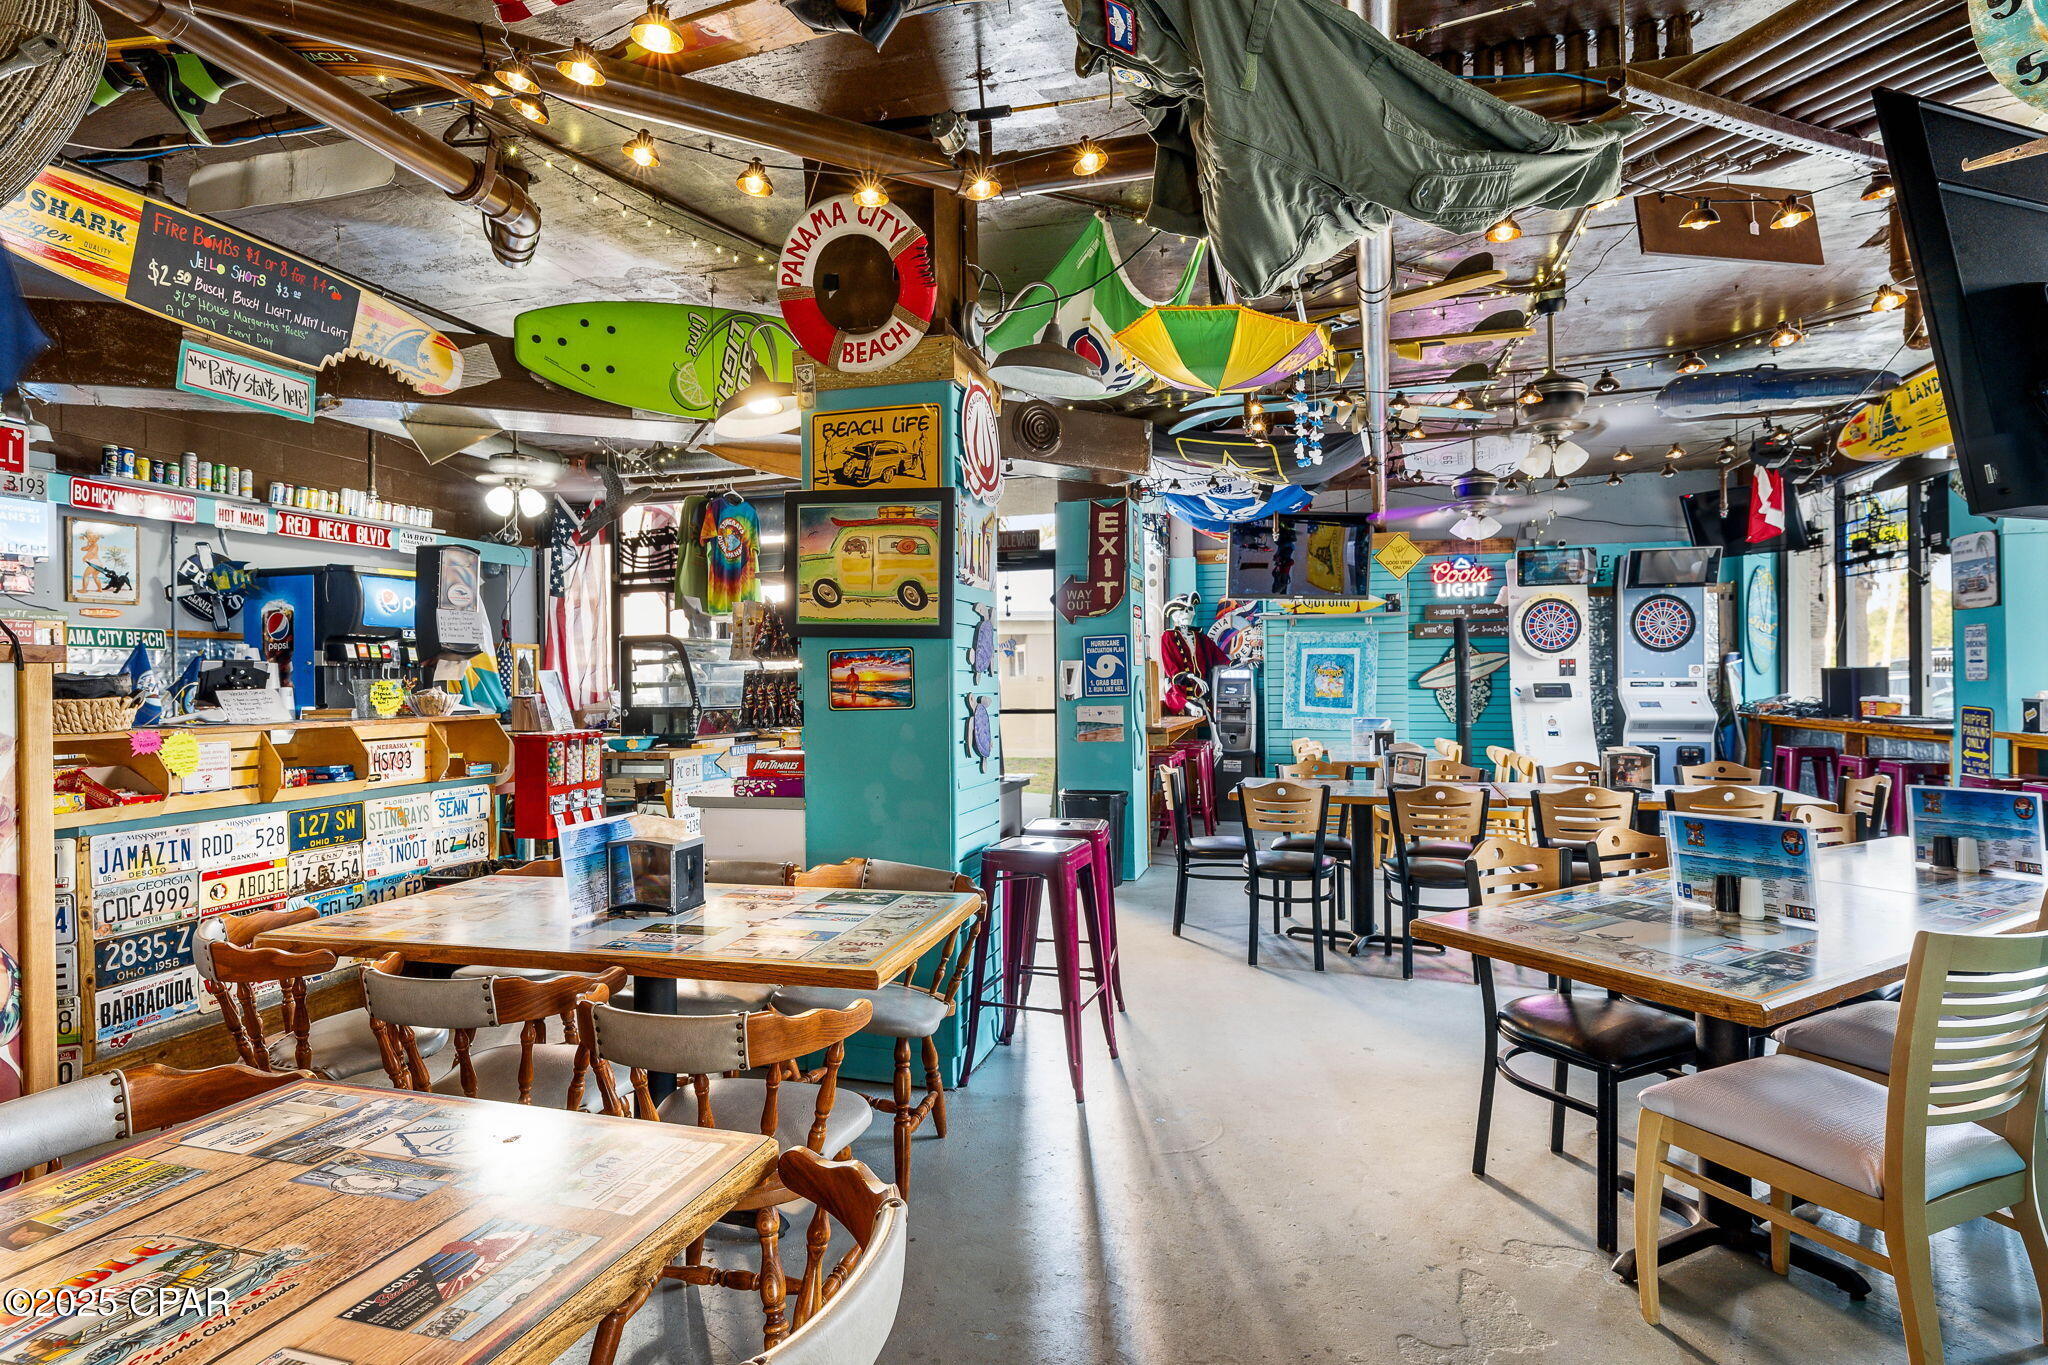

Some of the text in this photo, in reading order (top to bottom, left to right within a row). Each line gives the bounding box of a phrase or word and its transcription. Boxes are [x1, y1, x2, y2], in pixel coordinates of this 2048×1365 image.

[30, 188, 127, 243] SHARK
[83, 240, 112, 255] QUALITY
[781, 201, 908, 287] PANAMA CITY
[190, 251, 226, 275] JELLO
[230, 264, 267, 288] SHOTS
[280, 260, 288, 277] 8
[321, 320, 349, 341] LIGHT
[841, 321, 911, 364] BEACH
[188, 355, 208, 370] the
[208, 359, 242, 393] Party
[243, 373, 280, 402] Starts
[822, 418, 885, 439] BEACH
[74, 484, 90, 503] BO
[218, 508, 265, 528] HOT MAMA
[285, 514, 385, 547] RED NECK BLVD
[1096, 511, 1120, 605] EXIT
[1432, 561, 1492, 584] Coors
[1066, 589, 1093, 600] WAY
[1436, 582, 1488, 598] LIGHT
[1066, 600, 1092, 611] OUT
[97, 630, 123, 647] CITY
[126, 631, 164, 647] BEACH
[268, 640, 290, 652] pepsi
[1090, 639, 1120, 647] HURRICANE
[1086, 646, 1113, 654] EVACUATION
[1110, 678, 1124, 686] BEER
[1963, 713, 1989, 727] HIPPIE
[1963, 725, 1990, 739] PARKING
[731, 743, 756, 756] WARNING
[1965, 737, 1986, 750] ONLY
[373, 750, 412, 772] HS733
[1972, 761, 1990, 769] OTHERS
[384, 797, 414, 807] FLORIDA
[437, 796, 482, 819] SENN 1
[298, 808, 356, 838] 127 SW
[368, 804, 430, 831] STINGRAYS
[202, 825, 285, 859] RDD 528
[309, 835, 344, 848] OHIO 72
[380, 834, 409, 847] ALABAMA
[465, 831, 486, 849] 468
[99, 837, 191, 876] JAMAZIN
[230, 852, 259, 862] RANKIN
[315, 852, 338, 861] TENN
[102, 867, 167, 883] 06 DESOTO
[136, 874, 192, 892] GEORGIA
[383, 872, 415, 886] Kentucky
[202, 892, 289, 915] FLORIDA STATE UNIVERSITY
[309, 888, 347, 903] FLORIDA
[102, 885, 190, 925] CDC4999
[135, 915, 163, 926] HOUSTON
[155, 957, 180, 971] 1958
[121, 975, 175, 997] DREAMBOAT ANNIE
[101, 978, 194, 1029] BARRACUDA
[343, 1298, 376, 1319] PHIL
[382, 1267, 424, 1294] COLEY
